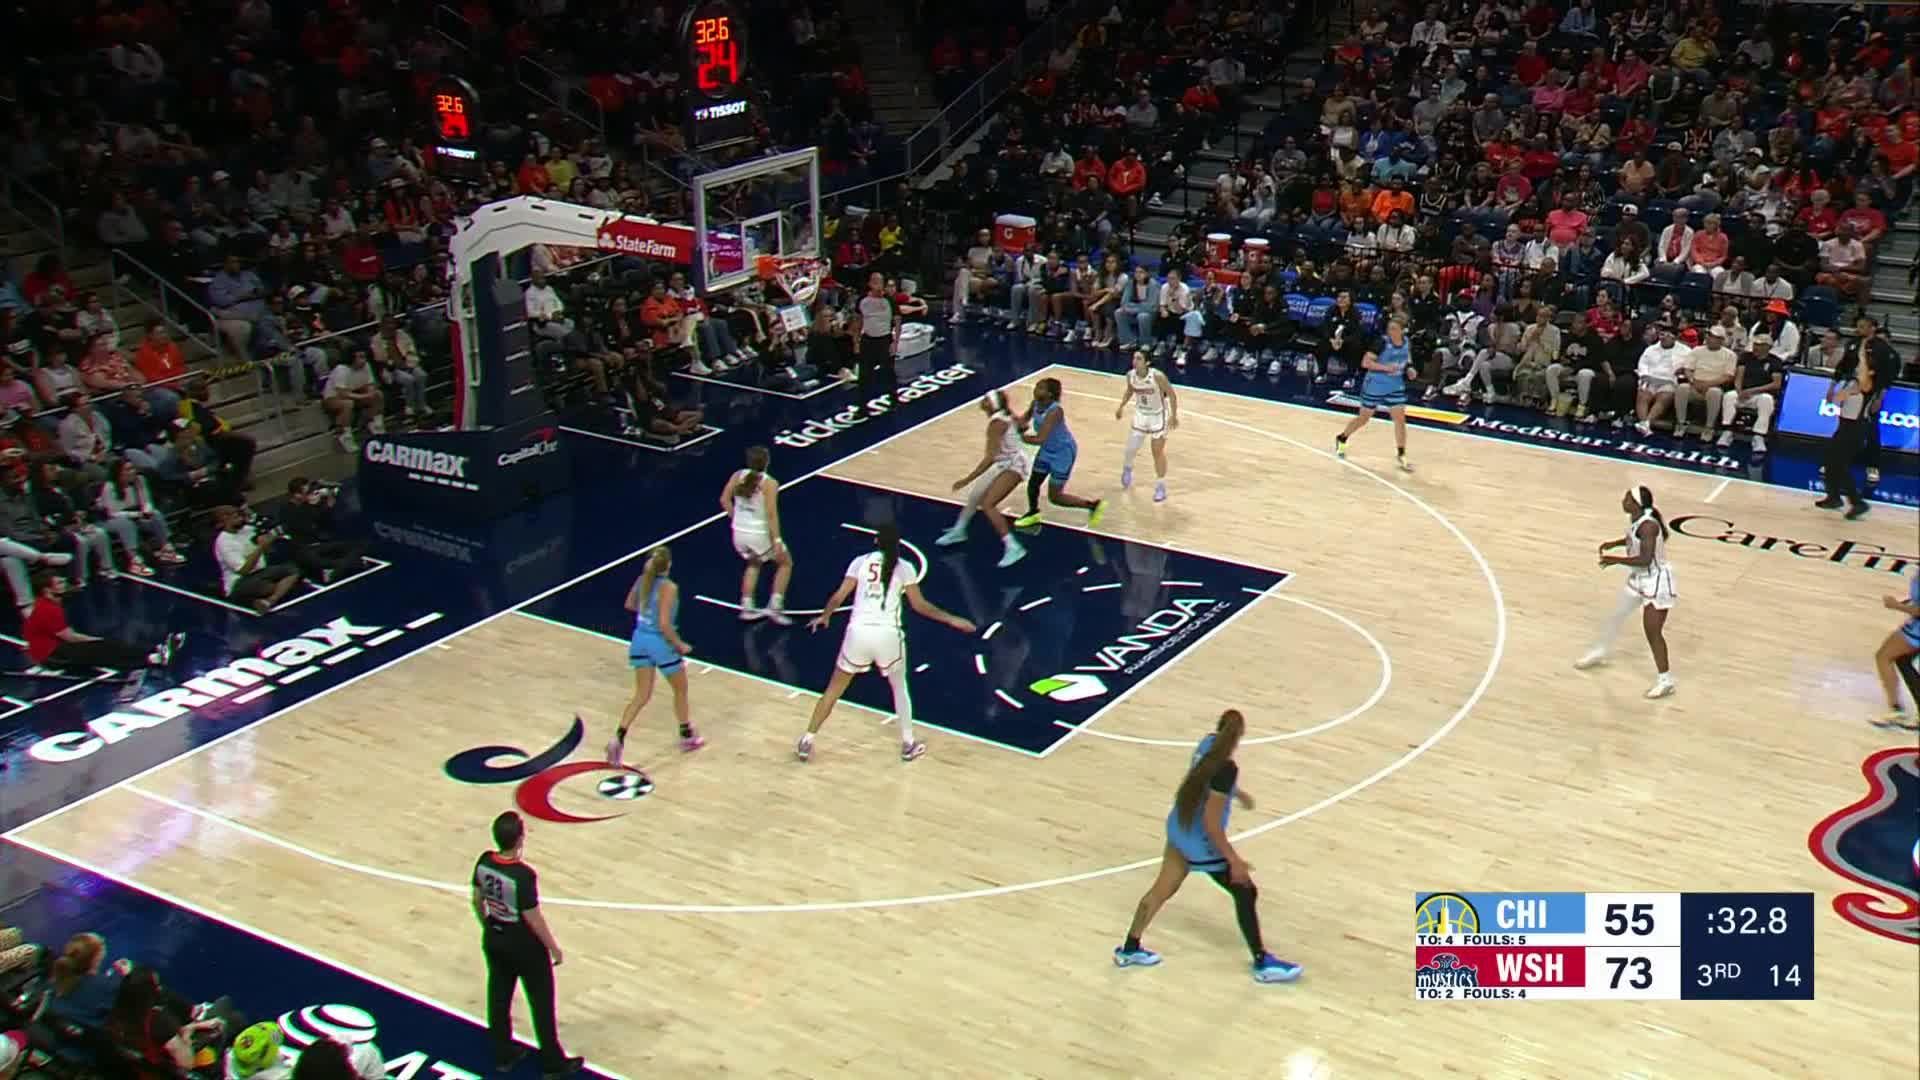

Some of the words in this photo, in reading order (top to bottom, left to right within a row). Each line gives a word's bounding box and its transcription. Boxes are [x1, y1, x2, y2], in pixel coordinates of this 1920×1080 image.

[695, 17, 729, 43] 32.6
[697, 41, 738, 88] 24
[436, 95, 463, 113] 32.6
[709, 101, 746, 118] TISSOT
[1470, 415, 1613, 448] MedStar
[1615, 440, 1740, 470] Health
[1073, 599, 1216, 672] VANDA
